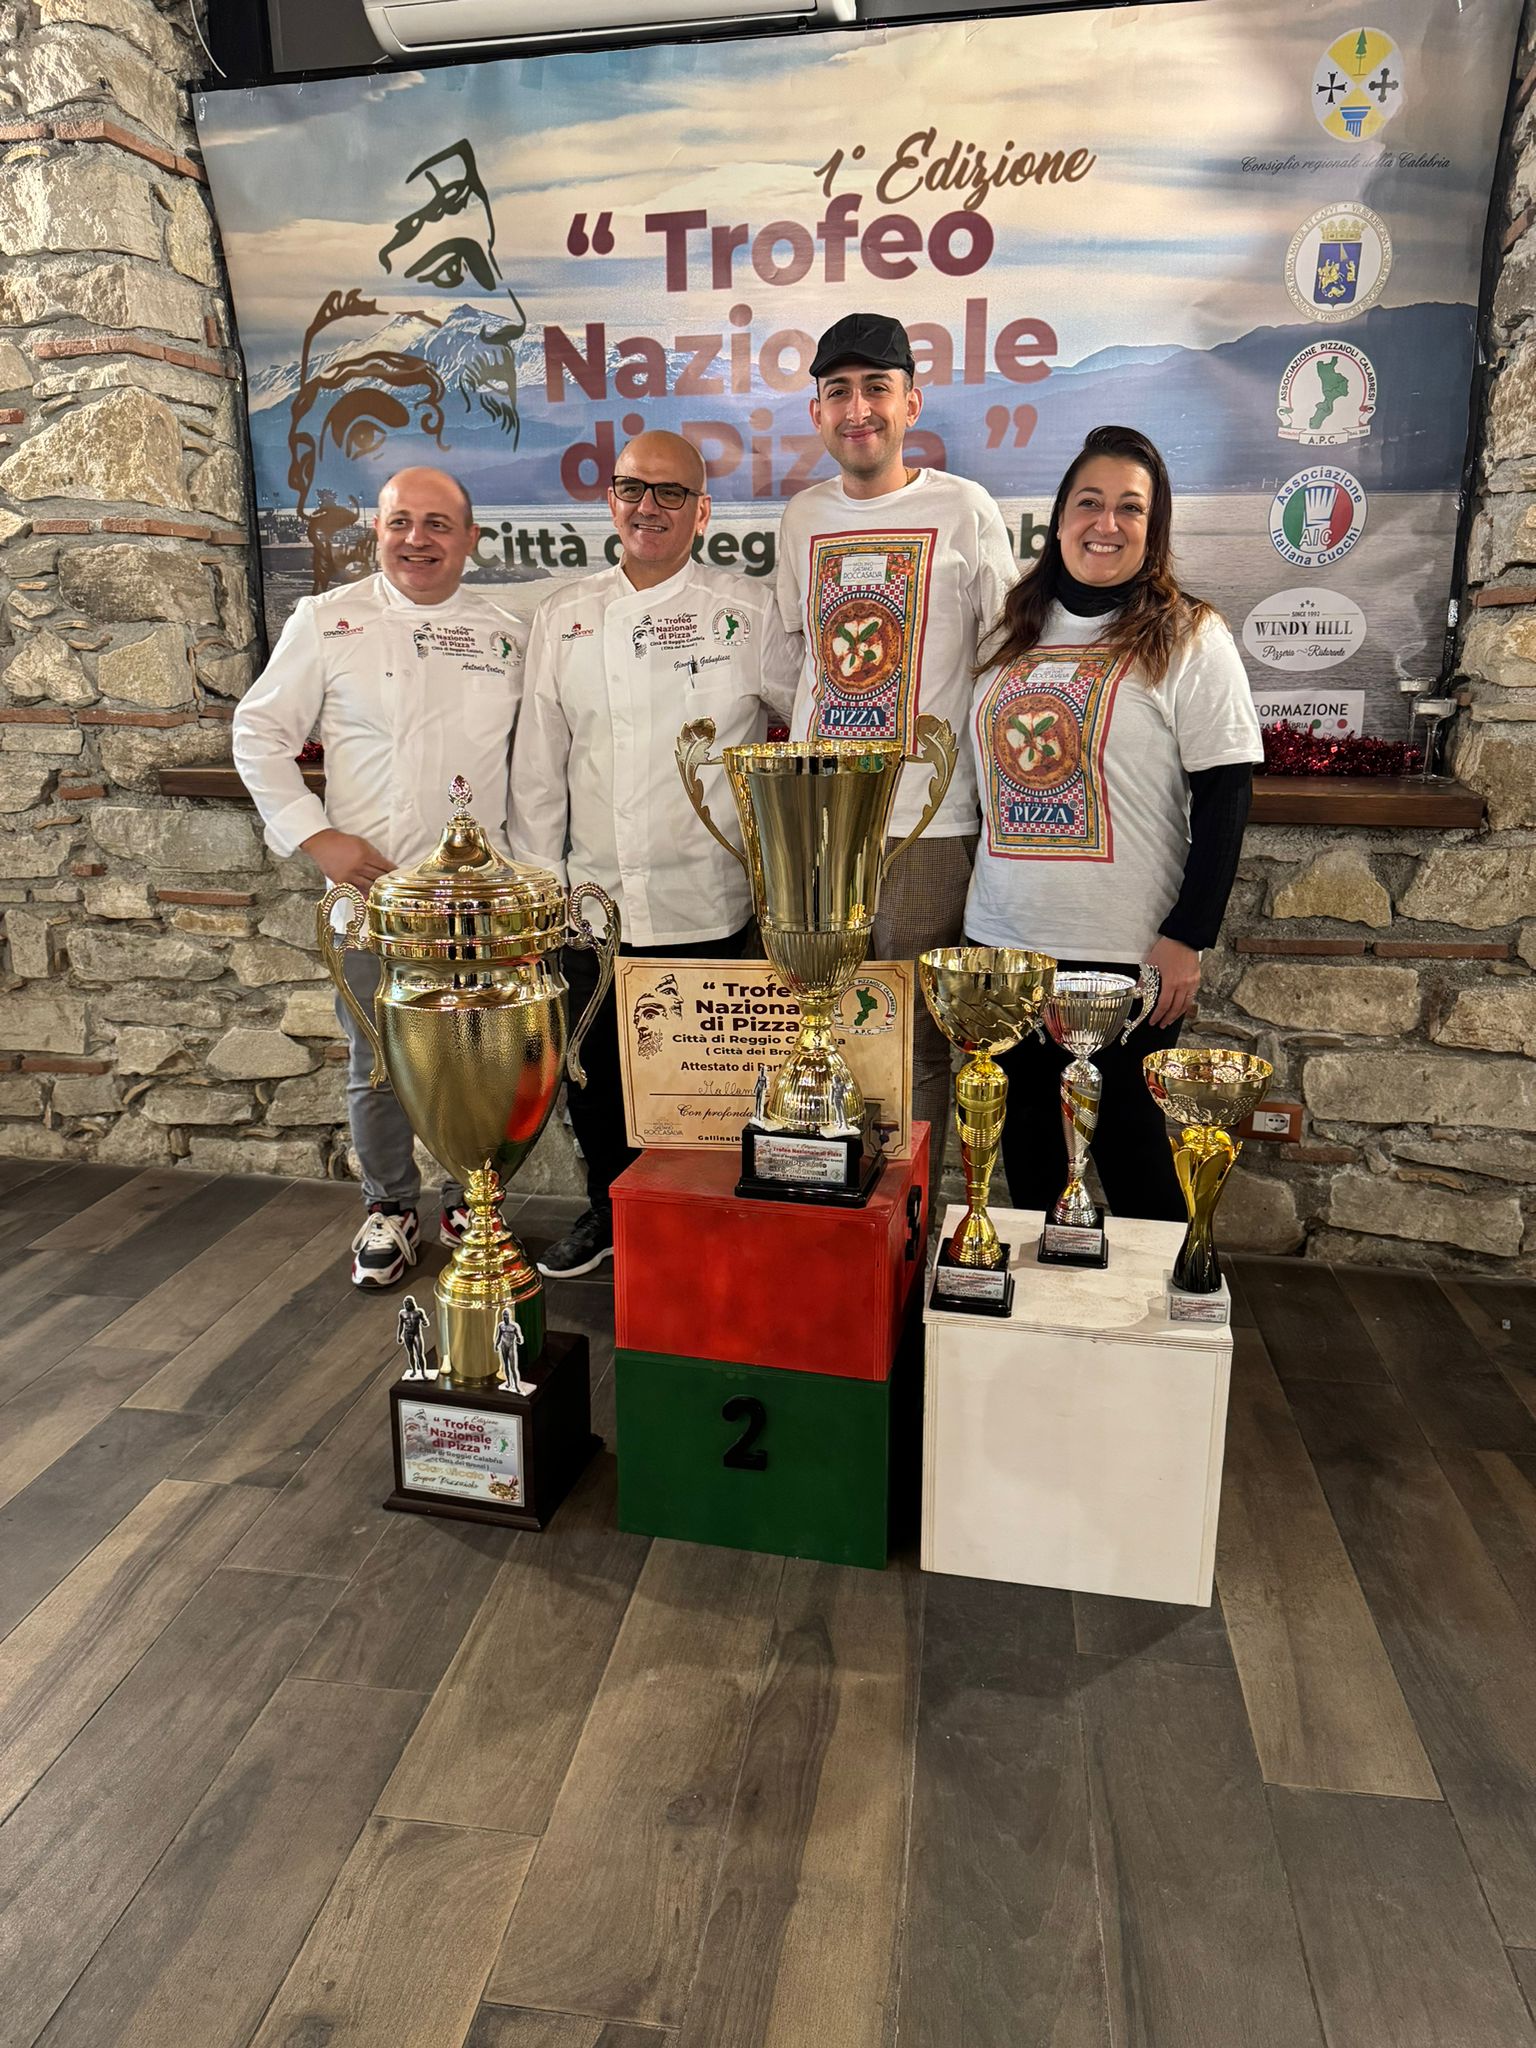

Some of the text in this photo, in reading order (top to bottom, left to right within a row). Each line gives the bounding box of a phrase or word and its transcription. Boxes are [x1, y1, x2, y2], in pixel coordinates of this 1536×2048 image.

[814, 127, 1097, 211] 1° Edizione
[645, 194, 995, 293] Trofeo
[543, 297, 1058, 403] Nazioale
[1280, 342, 1376, 401] ASSOCIAZIONE PIZZAIOLI CALABRESI
[1308, 435, 1338, 445] A.P.C.
[1276, 466, 1362, 506] Associazione
[470, 521, 588, 569] Città
[1298, 527, 1333, 547] AIC
[1272, 527, 1361, 565] Italiana Cuochi
[656, 624, 698, 634] Nazionale
[664, 617, 692, 625] Trofeo
[1254, 620, 1353, 636] WINDY HILL
[1262, 645, 1295, 660] Pizzeria
[829, 709, 881, 726] PIZZA
[1013, 805, 1069, 824] PIZZA
[722, 983, 792, 998] Trofe
[696, 999, 801, 1015] Naziona
[700, 1016, 800, 1032] di Pizza
[672, 1034, 707, 1043] Città
[711, 1034, 725, 1043] di
[729, 1035, 781, 1046] Reggio
[713, 1047, 743, 1055] Città
[746, 1047, 765, 1056] dei
[681, 1061, 739, 1072] Attestato
[742, 1062, 754, 1072] di
[677, 1103, 754, 1121] Con profonda
[443, 1418, 485, 1433] Trofeo
[721, 1393, 768, 1471] 2
[430, 1427, 492, 1445] Nazionale
[432, 1438, 443, 1449] di
[447, 1440, 481, 1454] Pizza
